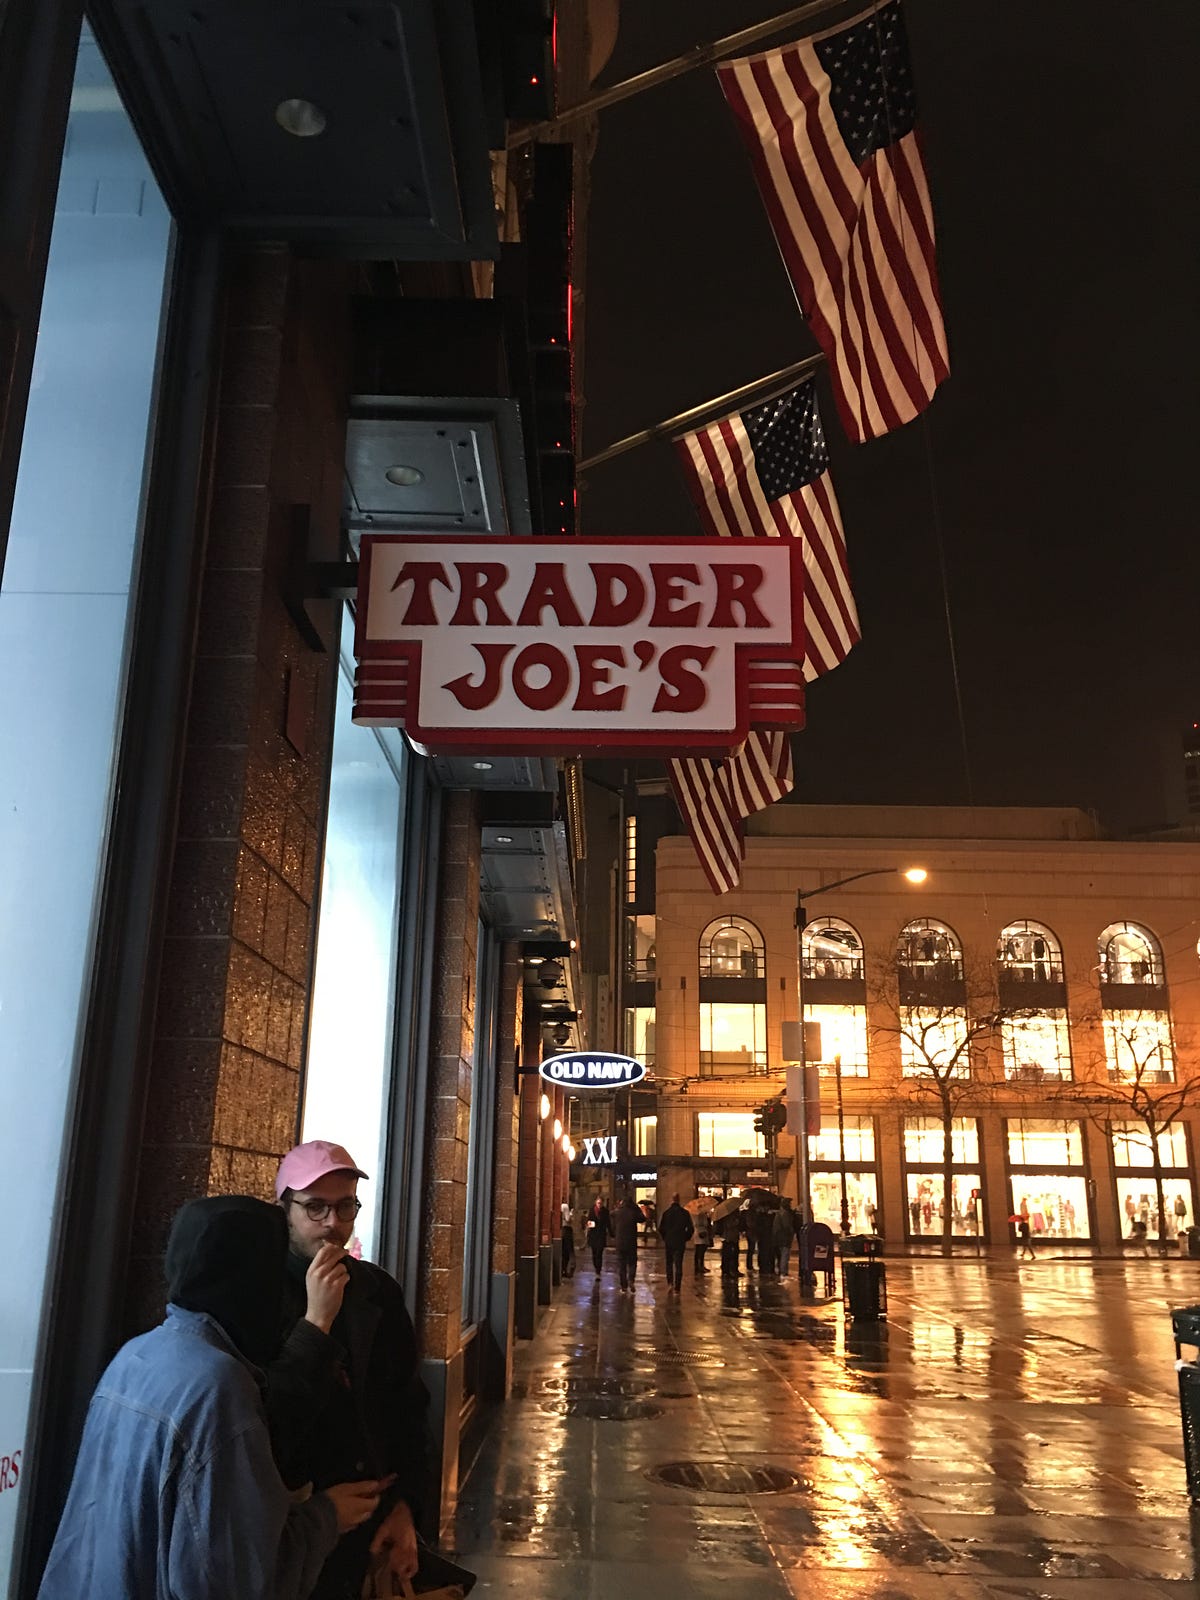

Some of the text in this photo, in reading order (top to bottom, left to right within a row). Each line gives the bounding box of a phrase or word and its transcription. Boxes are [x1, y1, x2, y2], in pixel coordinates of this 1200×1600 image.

[390, 562, 772, 628] TRADER
[441, 640, 716, 713] JOE'S
[550, 1061, 635, 1079] OLD NAVY
[582, 1136, 618, 1165] XXI
